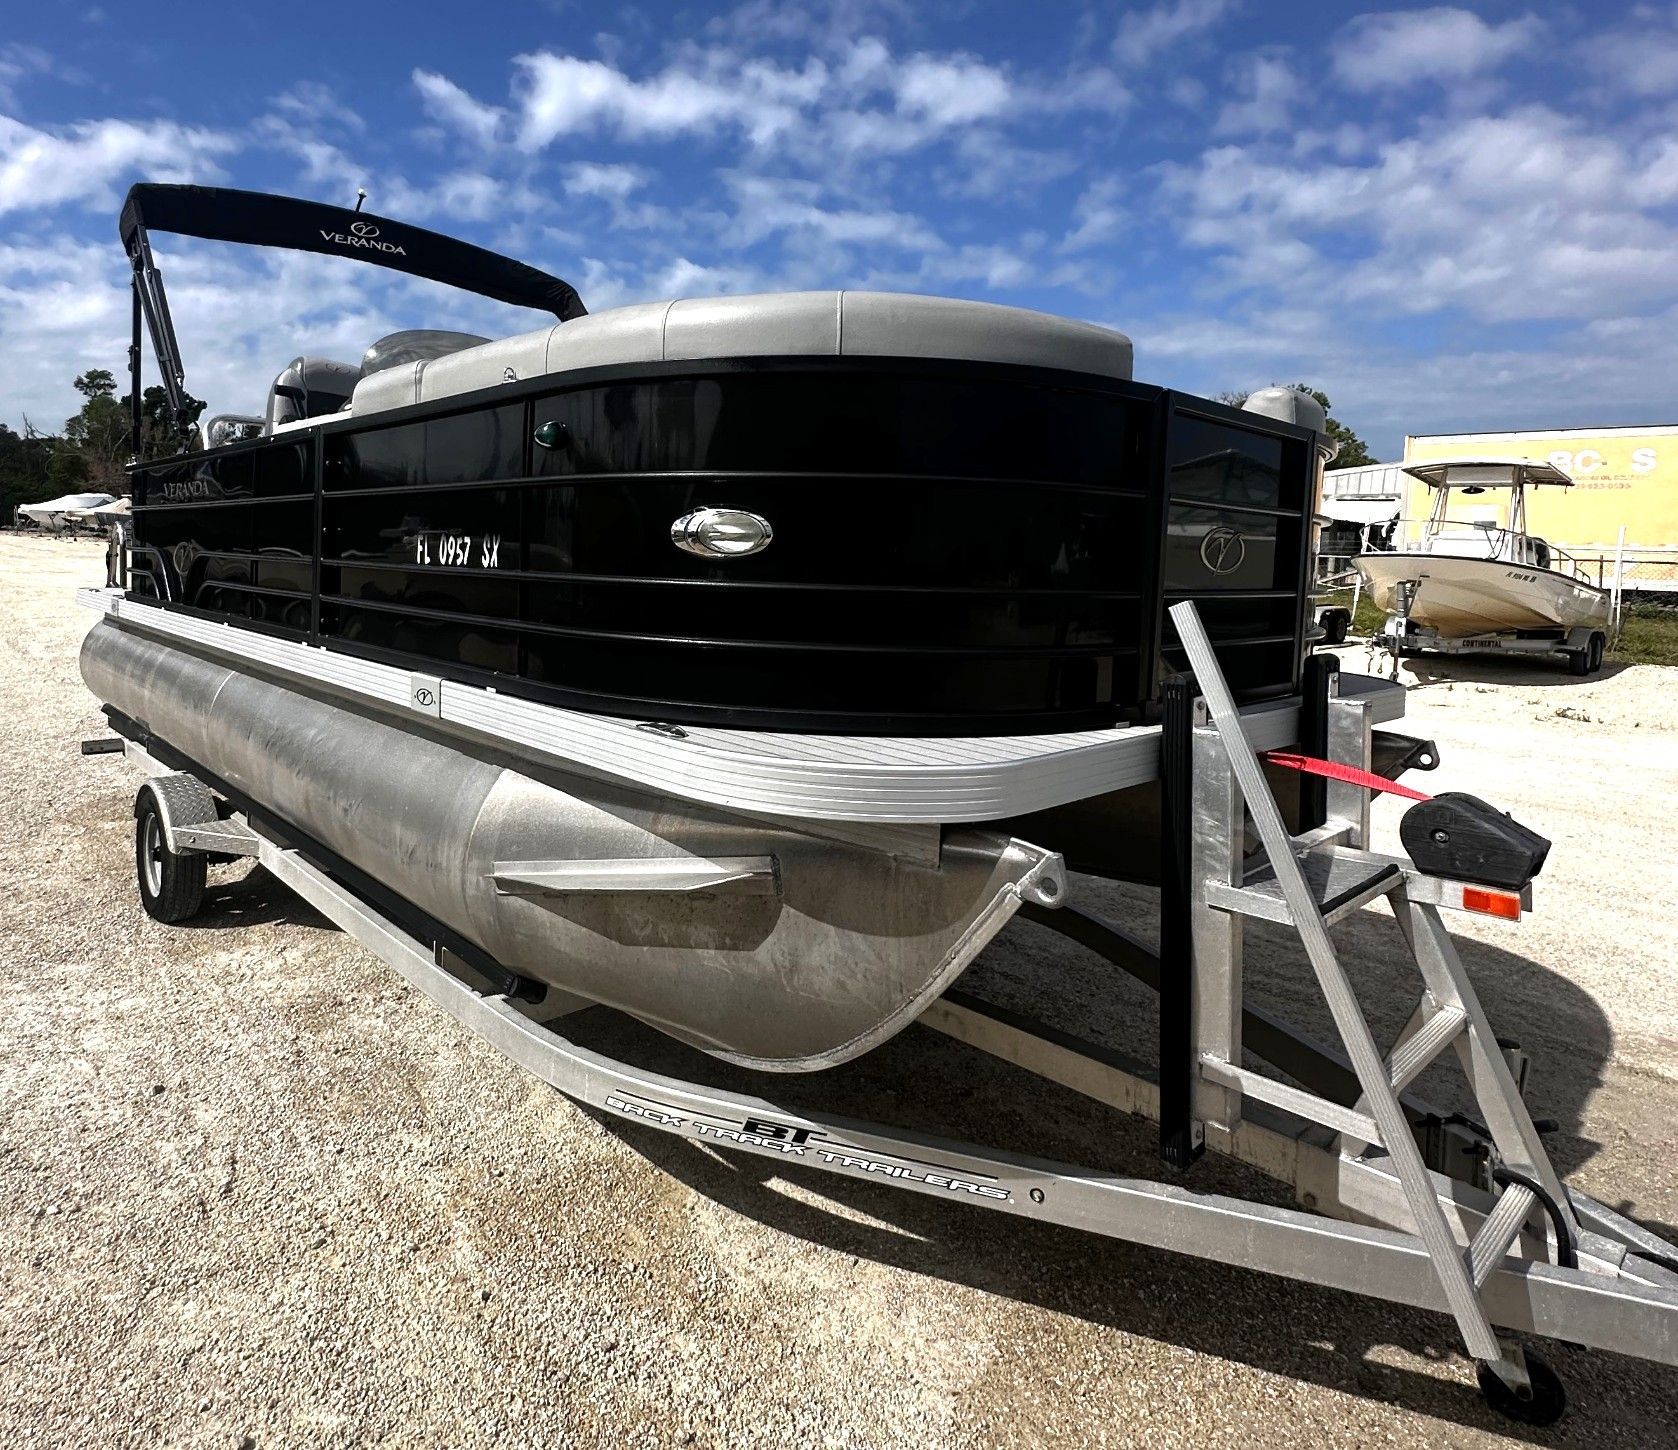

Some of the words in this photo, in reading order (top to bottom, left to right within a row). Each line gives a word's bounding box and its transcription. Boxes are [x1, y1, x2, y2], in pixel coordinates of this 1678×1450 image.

[320, 230, 407, 256] VERANDA
[163, 480, 209, 498] VERANDA
[416, 534, 431, 565] FL
[438, 533, 471, 566] 0957
[481, 533, 501, 568] SX
[1462, 639, 1502, 648] CONTINENTAL
[742, 1116, 828, 1146] BT
[605, 1096, 689, 1128] BACK
[693, 1121, 814, 1157] TRACK
[816, 1149, 1012, 1201] TRAILERS
